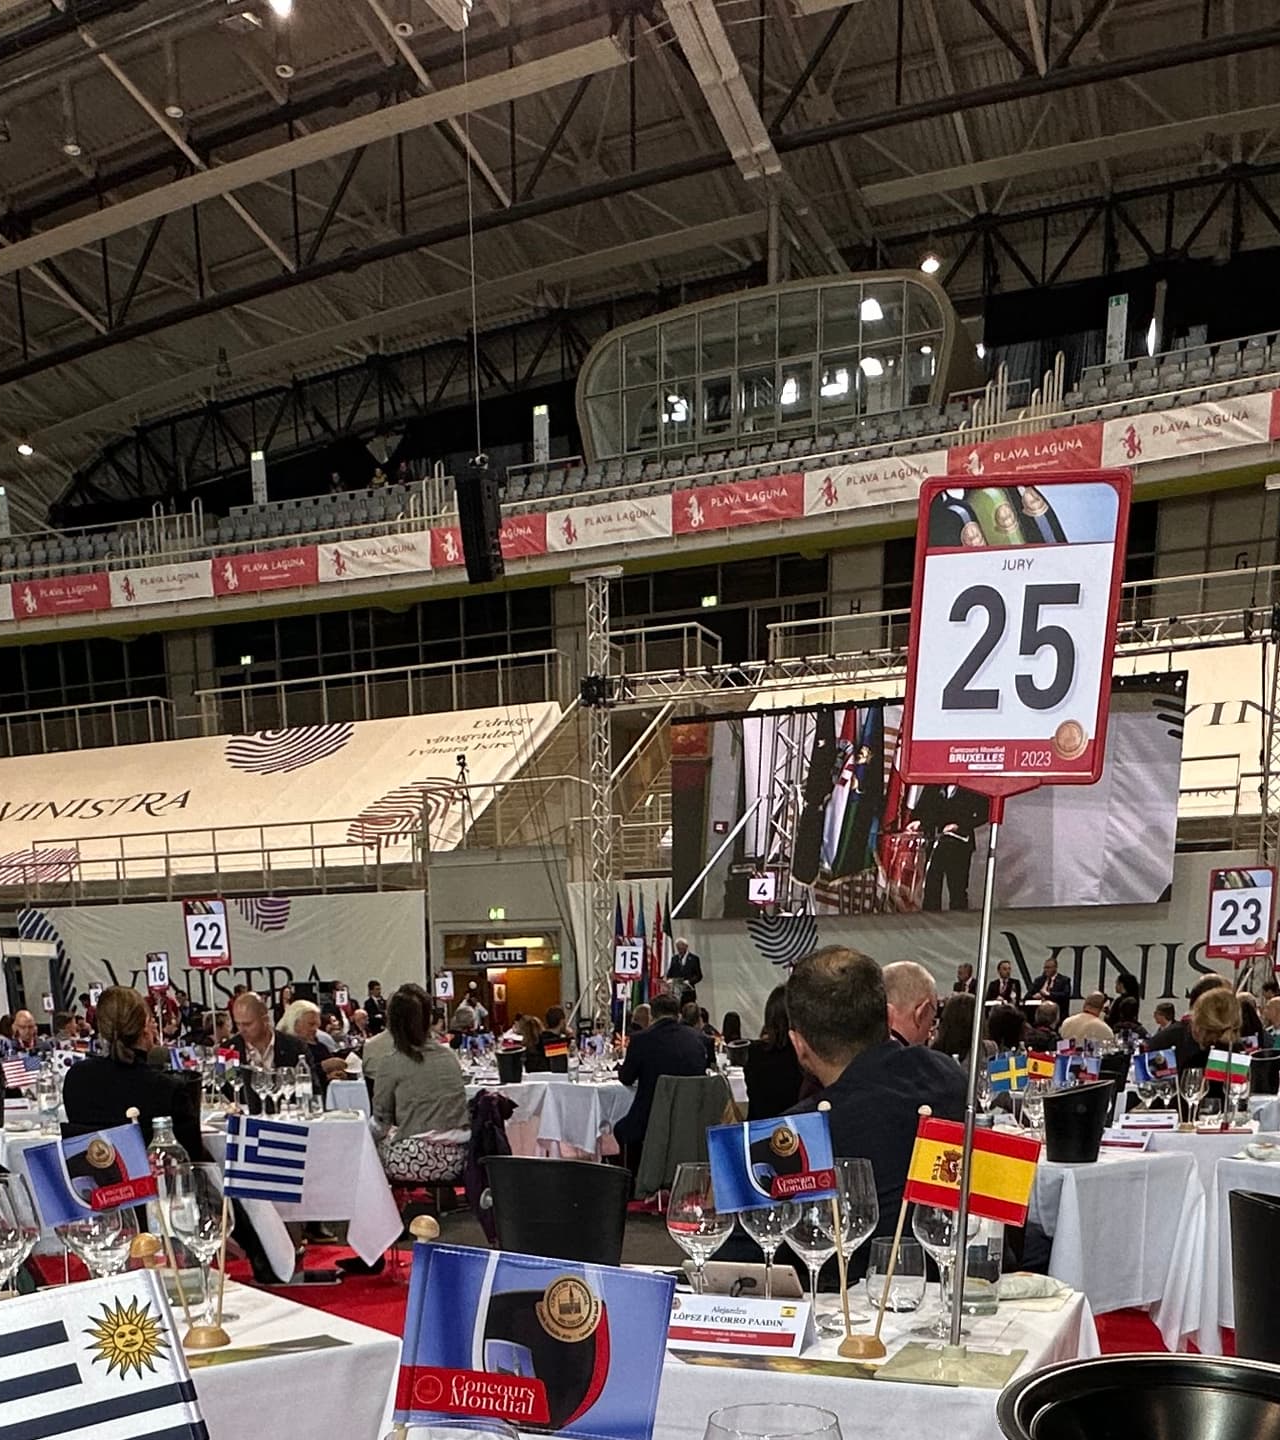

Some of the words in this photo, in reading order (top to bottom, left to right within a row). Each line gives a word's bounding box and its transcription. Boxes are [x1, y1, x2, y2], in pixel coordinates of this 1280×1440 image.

[1151, 419, 1191, 435] PLAVA
[1195, 410, 1250, 428] LAGUNA
[992, 447, 1029, 463] PLAVA
[1033, 438, 1084, 456] LAGUNA
[845, 473, 880, 487] PLAVA
[883, 465, 929, 482] LAGUNA
[710, 495, 743, 508] PLAVA
[745, 487, 789, 504] LAGUNA
[583, 515, 614, 527] PLAVA
[616, 508, 657, 523] LAGUNA
[501, 526, 533, 540] AGUNA
[242, 562, 269, 573] PLAVA
[271, 558, 305, 571] LAGUNA
[1001, 558, 1034, 572] JURY
[941, 583, 1081, 710] 25
[949, 753, 1005, 764] BRUXELLES
[1021, 751, 1052, 767] 2023
[757, 884, 767, 897] 4
[1219, 898, 1262, 936] 23
[194, 922, 224, 951] 22
[474, 950, 524, 962] TOILETTE
[619, 949, 639, 970] 15
[151, 966, 166, 983] 16
[440, 980, 449, 994] 9
[451, 1374, 535, 1399] Concours
[449, 1390, 535, 1416] Mondial
